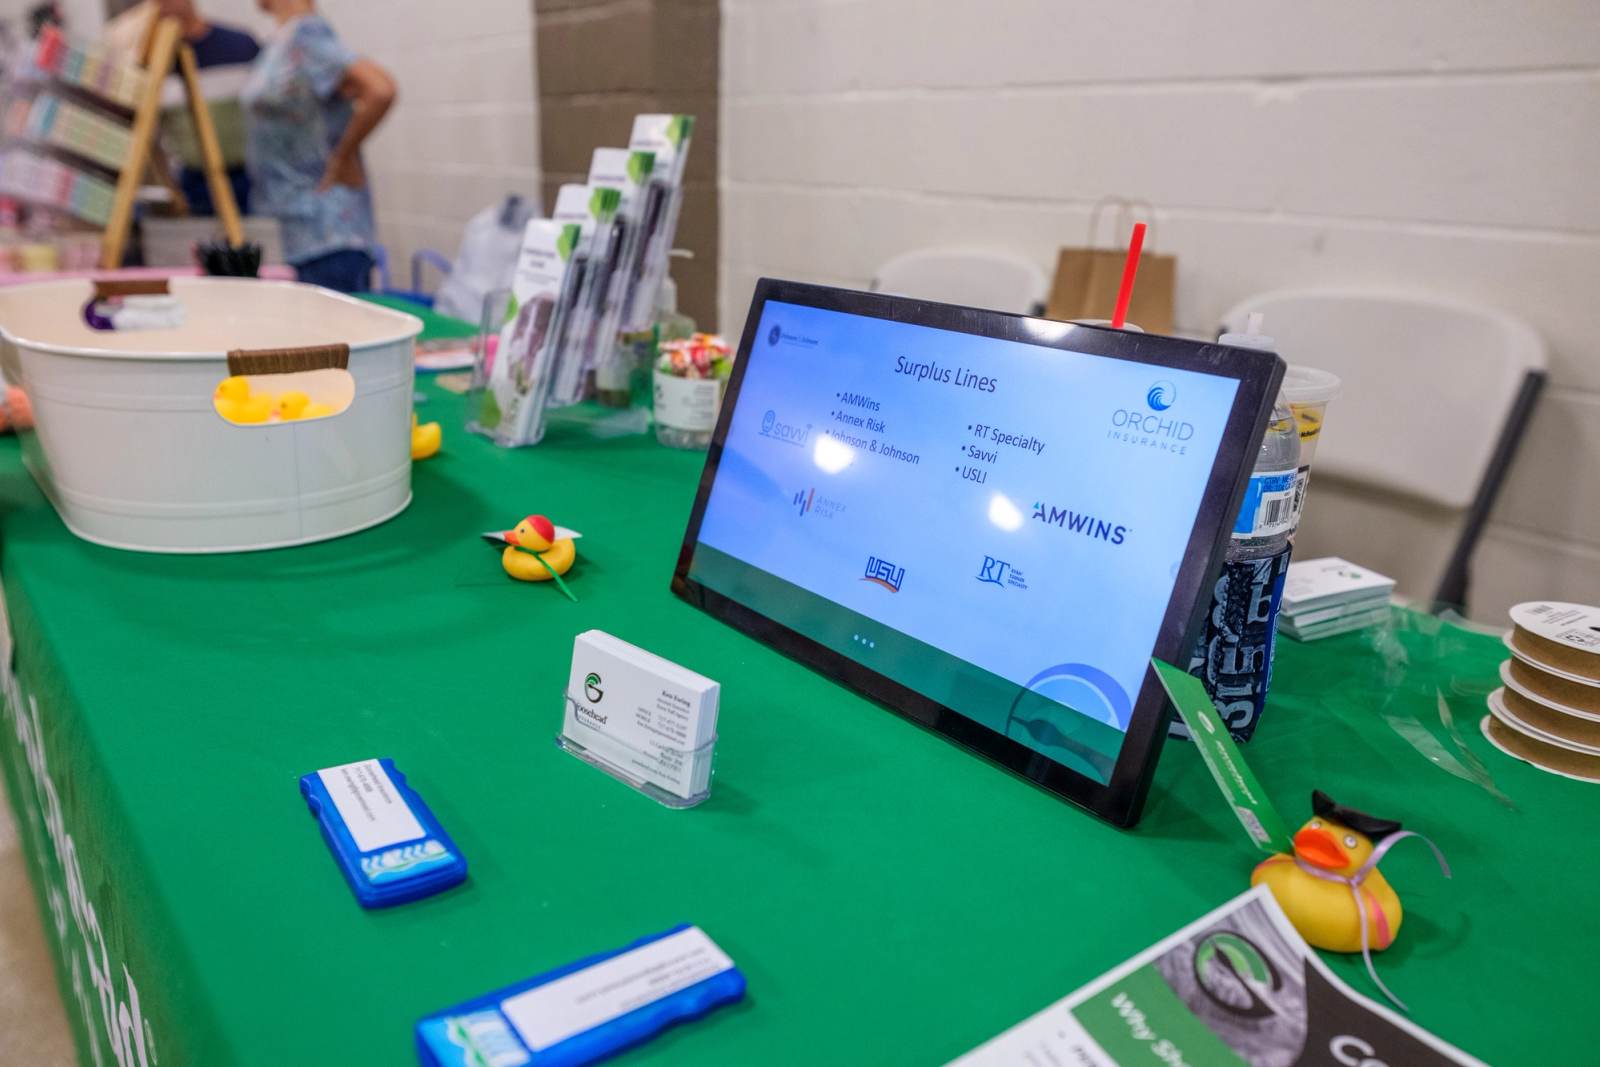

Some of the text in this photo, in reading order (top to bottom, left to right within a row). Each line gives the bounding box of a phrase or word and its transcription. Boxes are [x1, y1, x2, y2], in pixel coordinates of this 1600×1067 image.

[894, 355, 998, 393] Surplus Lines
[840, 391, 881, 412] AMWins
[835, 410, 886, 433] Annex Risk
[1112, 408, 1195, 441] ORCHID
[869, 439, 878, 453] &
[878, 443, 920, 465] Johnson
[974, 423, 1045, 456] RT Specialty
[1106, 430, 1187, 456] INSURANCE
[967, 444, 998, 465] Savvi
[962, 465, 988, 484] USLI
[1032, 502, 1127, 545] AMWINS
[978, 554, 1011, 582] RT
[1111, 991, 1158, 1041] Why
